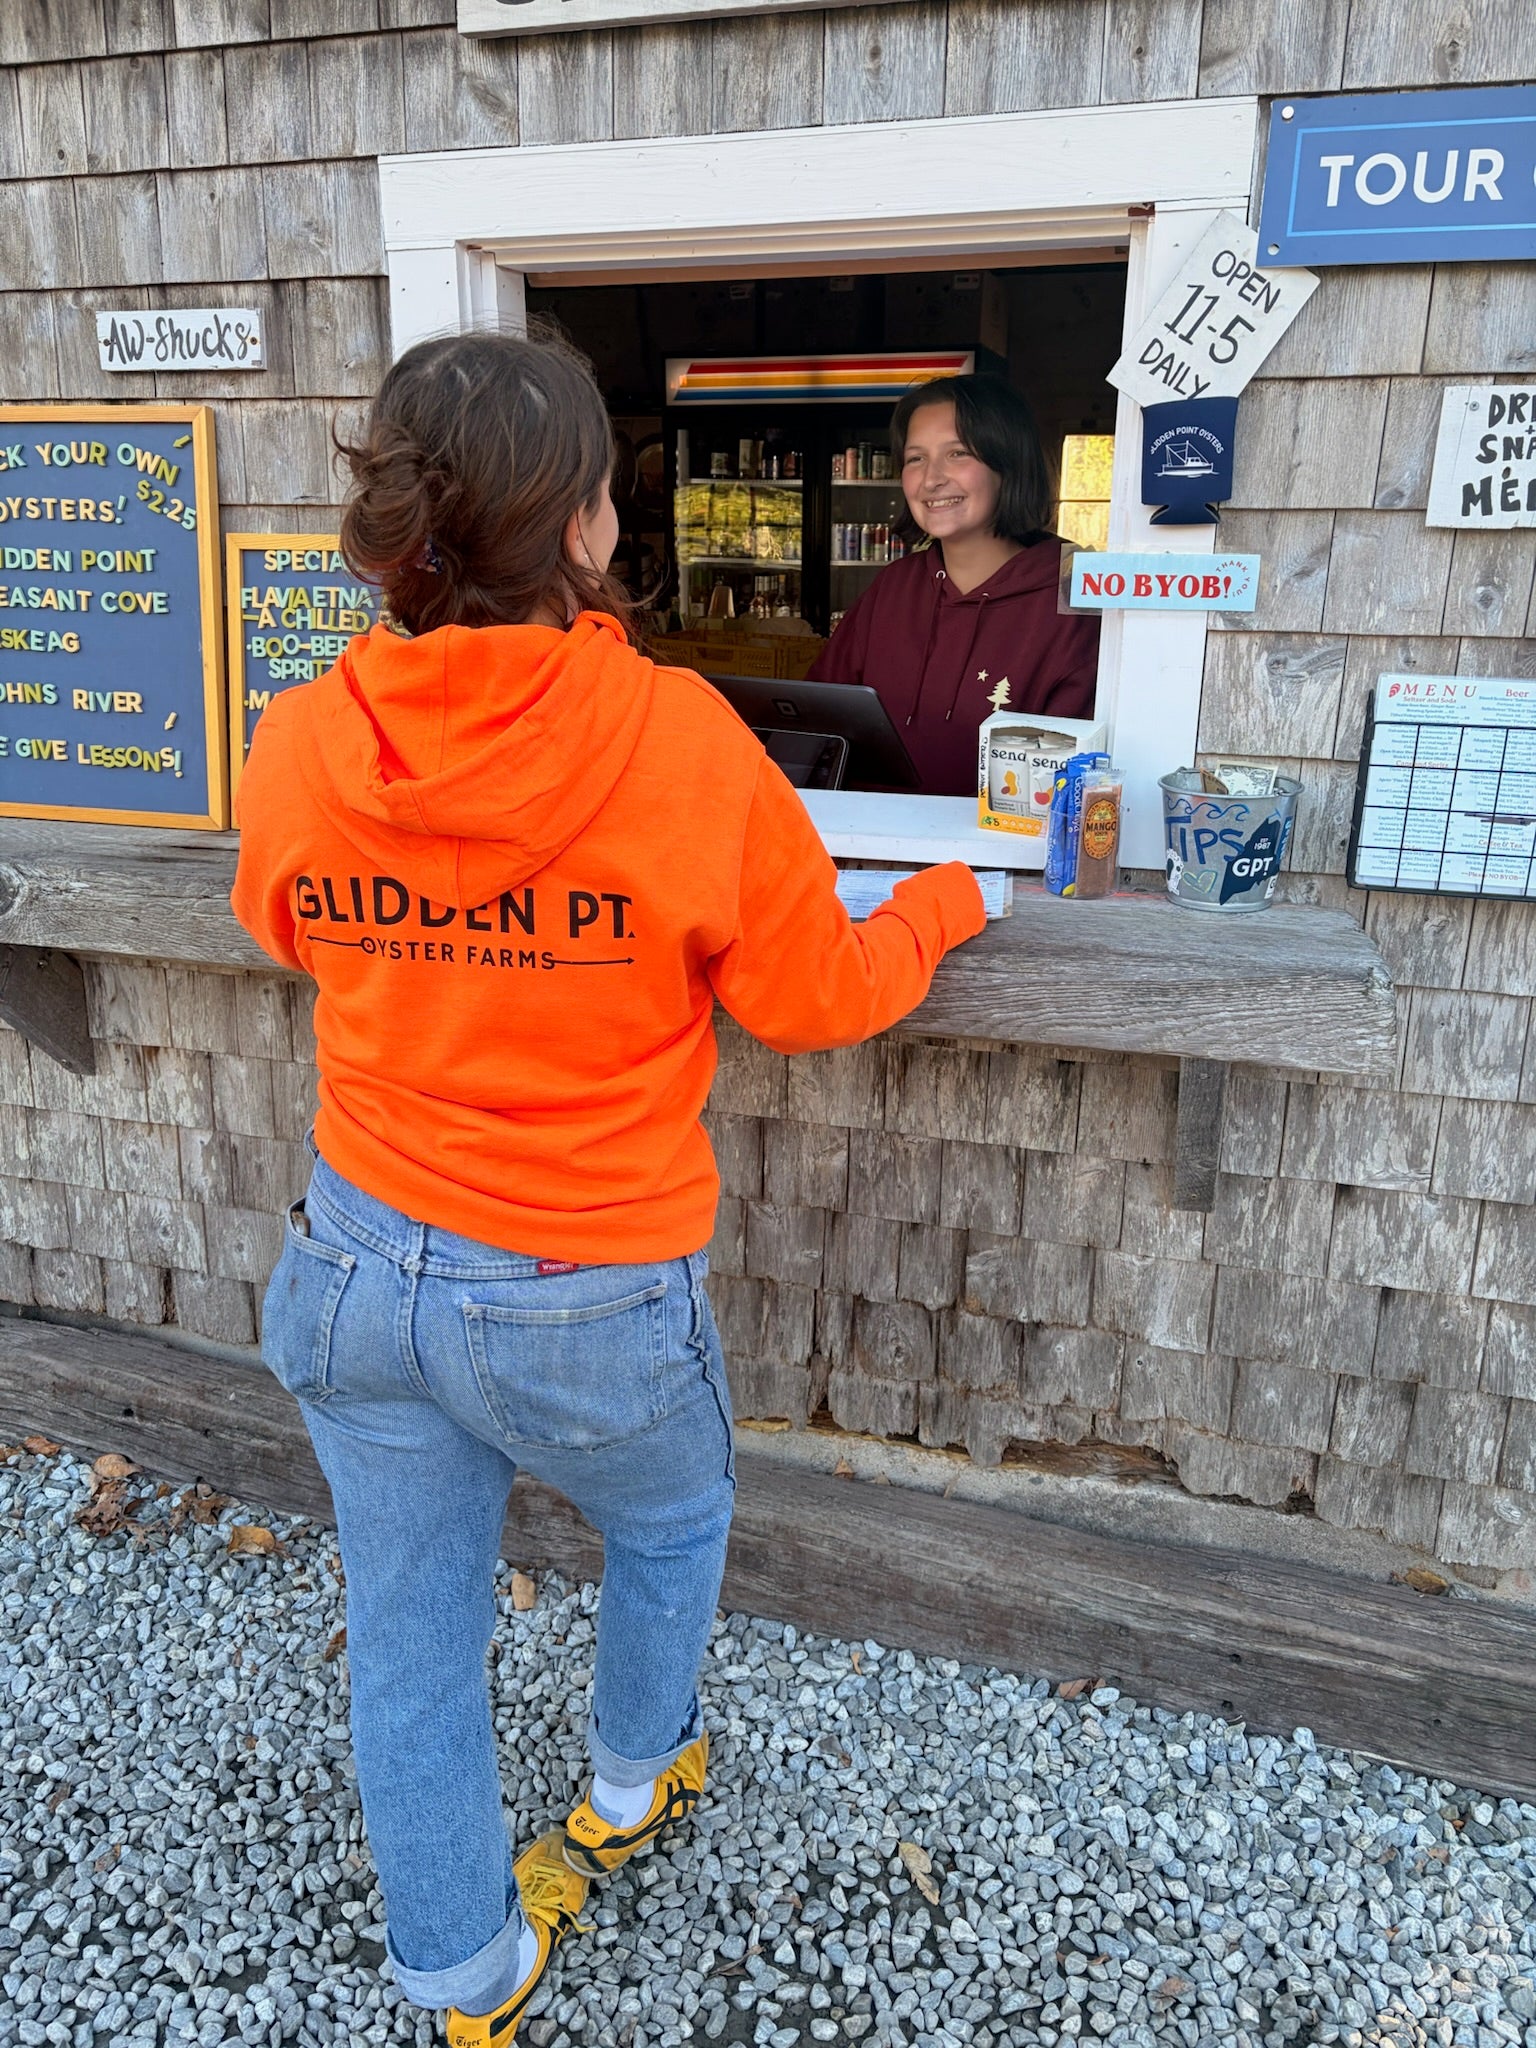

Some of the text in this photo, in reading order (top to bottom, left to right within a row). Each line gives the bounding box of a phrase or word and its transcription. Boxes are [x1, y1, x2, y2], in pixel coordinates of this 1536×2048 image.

[1319, 148, 1504, 208] TOUR
[1211, 249, 1281, 314] OPEN
[1163, 283, 1256, 365] 11-5
[1138, 337, 1211, 399] DAILY
[1175, 426, 1199, 436] POINT
[1198, 428, 1225, 454] OYSTERS
[35, 441, 107, 467] YOUR
[117, 443, 181, 487] OWN
[136, 479, 197, 530] $2.25
[81, 549, 157, 573] POINT
[1215, 560, 1249, 573] THANK
[242, 586, 375, 609] FLAVIA ETNA
[1081, 573, 1232, 599] NO BYOB!
[0, 586, 169, 614] EASANT COVE
[281, 607, 370, 632] CHILLED
[268, 658, 336, 681] SPRIT
[72, 688, 143, 713] RIVER
[1403, 683, 1478, 698] MENU
[1505, 688, 1530, 698] Beer
[15, 738, 68, 761] GIVE
[77, 743, 183, 778] LESSONS!
[1086, 821, 1117, 832] MANGO
[1165, 815, 1246, 865] TIPS
[1478, 839, 1501, 848] Cofee
[296, 875, 637, 940] GLIDDEN PT.
[362, 937, 556, 971] OYSTER FARMS
[575, 1816, 600, 1835] Tiger
[456, 2035, 482, 2048] Tiger
